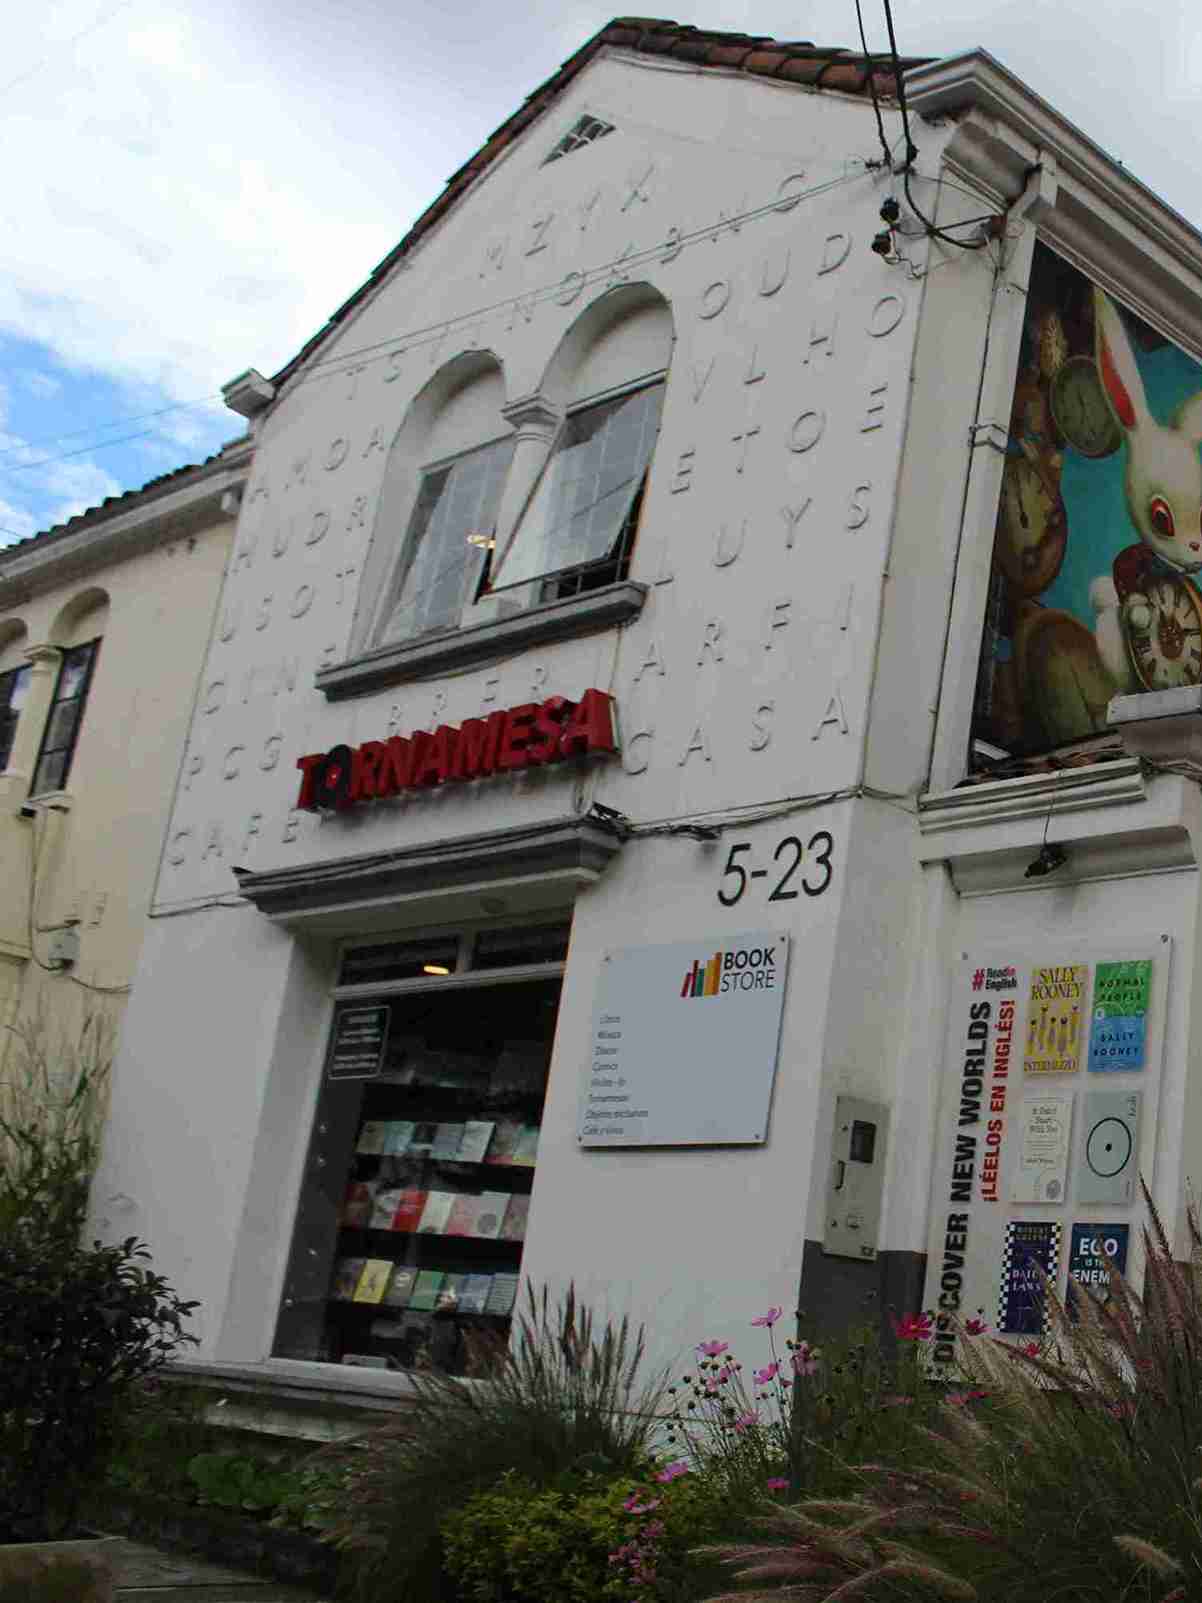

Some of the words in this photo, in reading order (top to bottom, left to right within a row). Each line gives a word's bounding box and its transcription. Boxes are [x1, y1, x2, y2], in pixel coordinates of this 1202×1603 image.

[296, 687, 621, 811] TORNAMESA
[718, 831, 833, 906] 5-23
[723, 948, 777, 970] BOOK
[720, 969, 777, 993] STORE
[1039, 967, 1077, 983] SALLY
[1031, 983, 1082, 1000] ROONEY
[958, 1001, 991, 1126] WORLDS
[990, 1086, 1007, 1112] EN
[950, 1134, 977, 1202] NEW
[1072, 1269, 1111, 1284] ENEM
